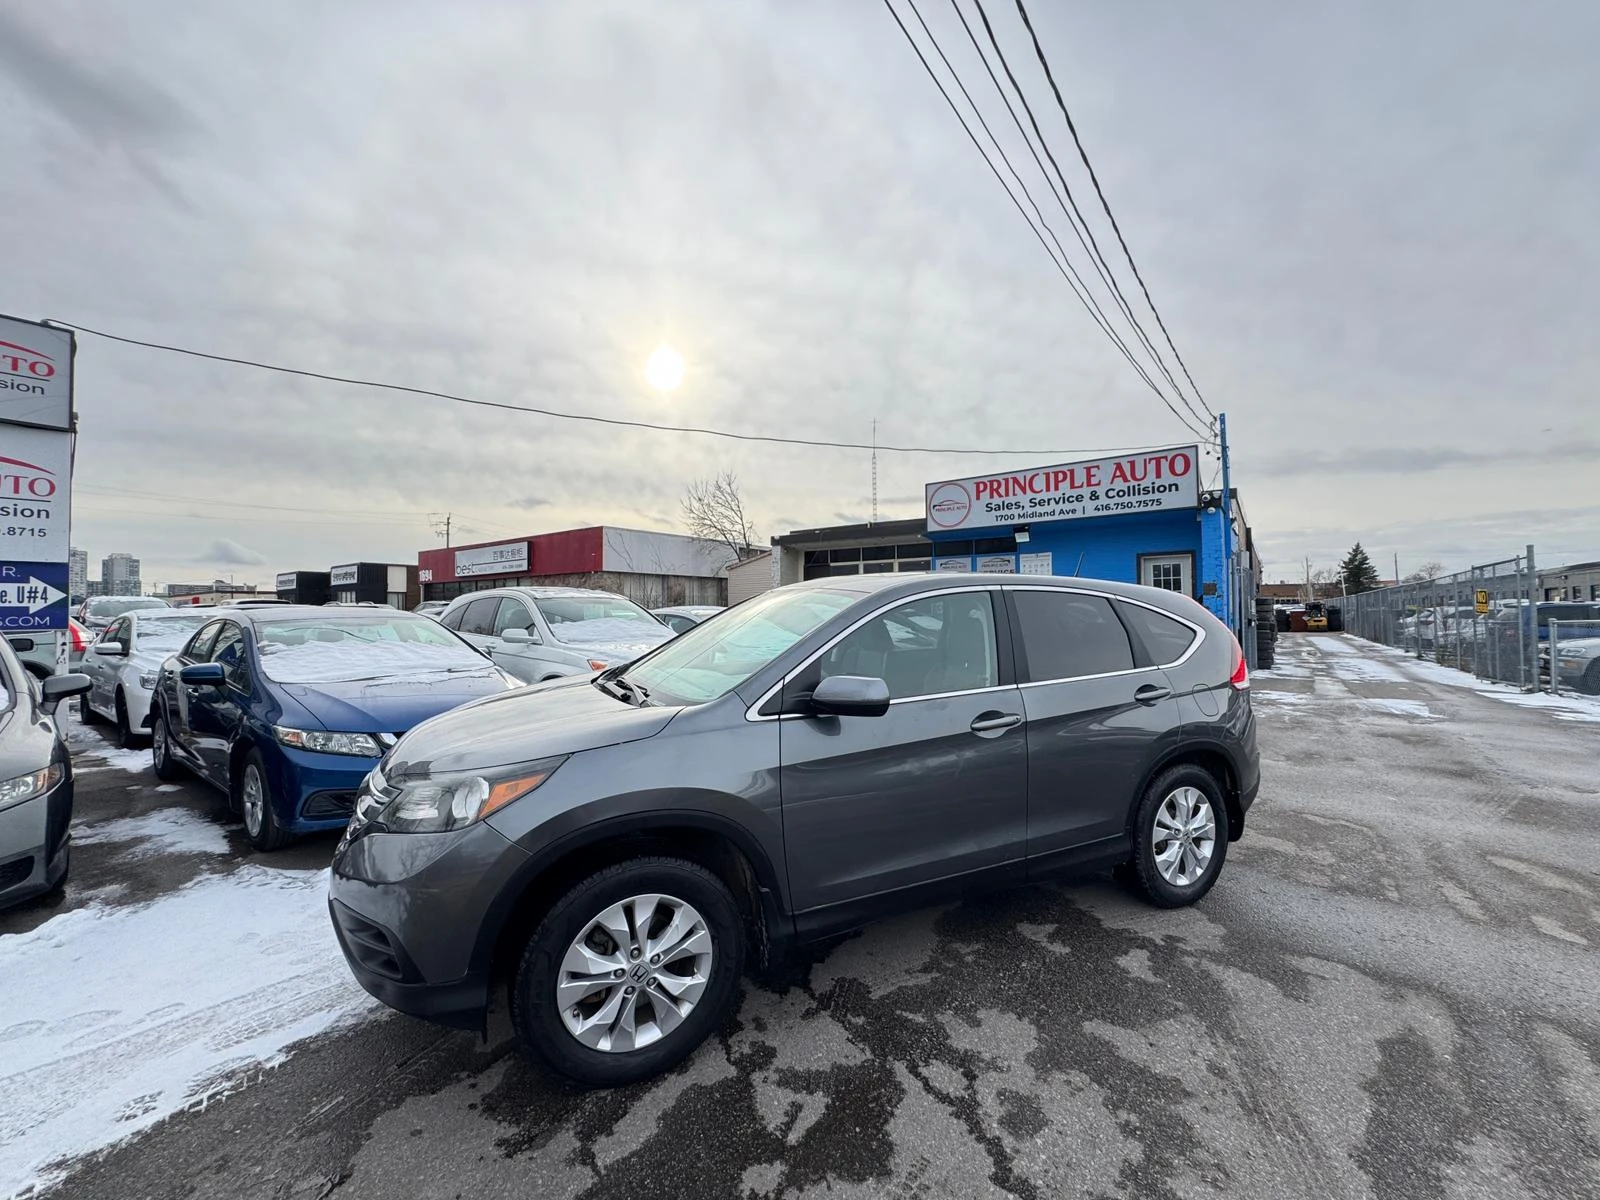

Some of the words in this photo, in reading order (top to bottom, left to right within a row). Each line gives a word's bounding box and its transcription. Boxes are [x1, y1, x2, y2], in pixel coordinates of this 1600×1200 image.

[0, 474, 56, 497] TO
[973, 464, 1102, 501] PRINCIPLE
[1110, 453, 1191, 485] AUTO
[985, 500, 1025, 513] Sales,
[1029, 492, 1085, 509] Service
[1089, 490, 1100, 501] &
[1105, 481, 1180, 500] Collision
[995, 513, 1015, 522] 1700
[1018, 508, 1056, 520] Midland
[1058, 507, 1077, 517] Ave
[1094, 498, 1163, 512] 416.750.7575
[0, 526, 47, 538] .8715
[16, 586, 49, 604] U#4
[0, 616, 50, 627] .COM
